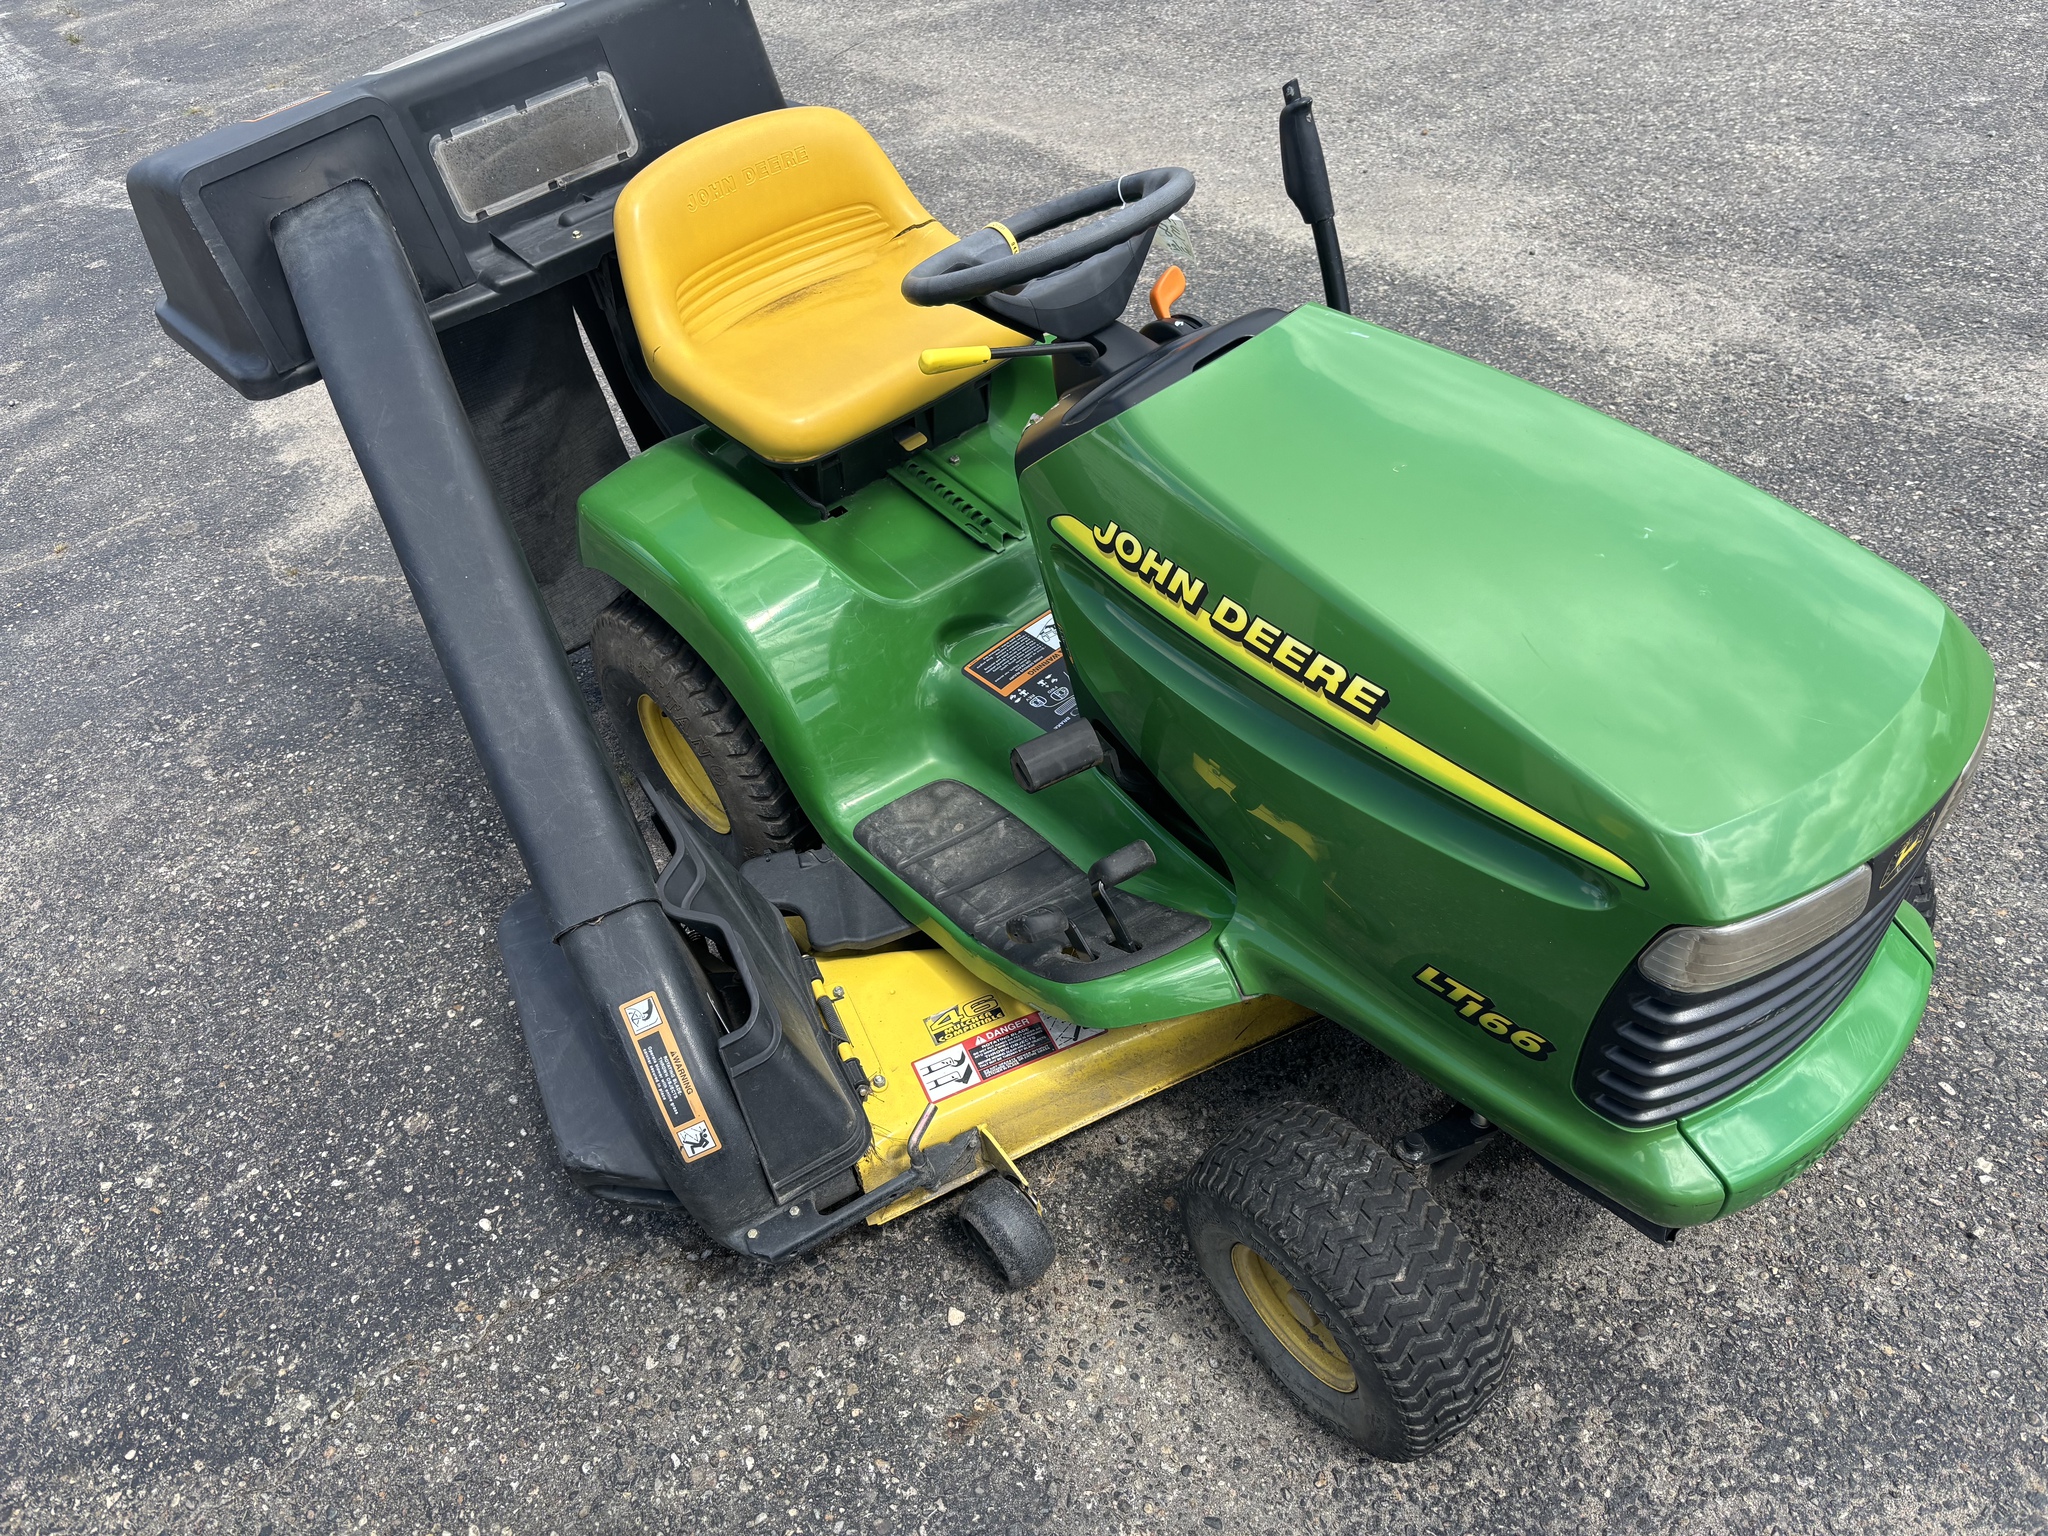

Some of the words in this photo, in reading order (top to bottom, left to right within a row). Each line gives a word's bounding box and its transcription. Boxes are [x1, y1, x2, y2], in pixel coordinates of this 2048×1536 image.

[687, 175, 737, 212] JOHN
[742, 145, 809, 186] DEERE
[1092, 520, 1207, 612] JOHN
[1210, 596, 1388, 721] DEERE
[1027, 653, 1060, 676] WARNING
[638, 661, 715, 756] TITAN
[930, 994, 998, 1032] 46
[939, 1012, 1003, 1041] COMPATIBLE
[944, 1011, 992, 1034] MULCHER
[985, 1017, 1030, 1040] DANGER
[1413, 965, 1553, 1057] LT166
[666, 1077, 678, 1099] OBJECTS
[673, 1055, 694, 1095] WARNING
